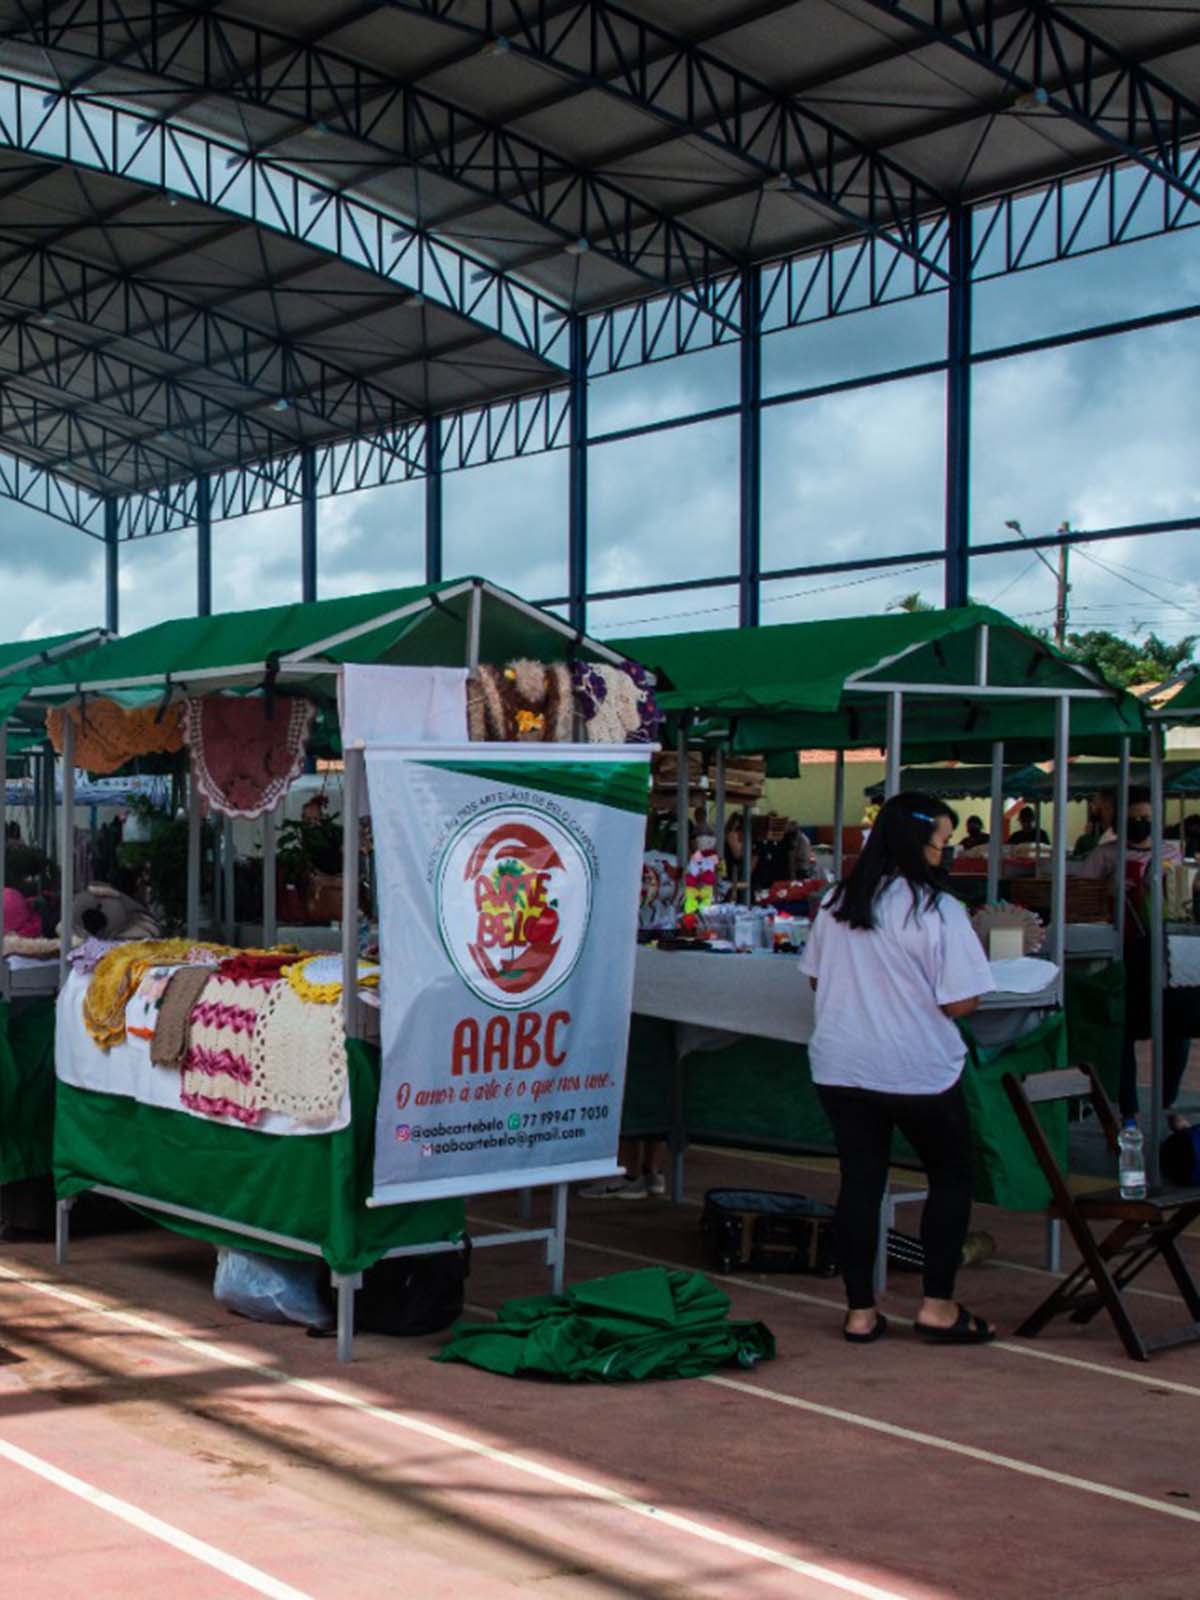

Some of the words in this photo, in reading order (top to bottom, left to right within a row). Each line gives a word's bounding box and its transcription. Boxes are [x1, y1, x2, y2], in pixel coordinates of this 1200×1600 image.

[474, 872, 552, 912] ARTE
[477, 908, 560, 948] BELO
[451, 1010, 571, 1076] AABC
[396, 1082, 411, 1110] O
[415, 1086, 454, 1106] amor
[474, 1078, 501, 1101] arte
[517, 1081, 526, 1097] o
[531, 1079, 557, 1103] que
[558, 1075, 580, 1092] nos
[411, 1117, 504, 1141] @aabcartebelo
[522, 1113, 537, 1127] 77
[432, 1128, 586, 1155] aabcartebelo@gmail.com
